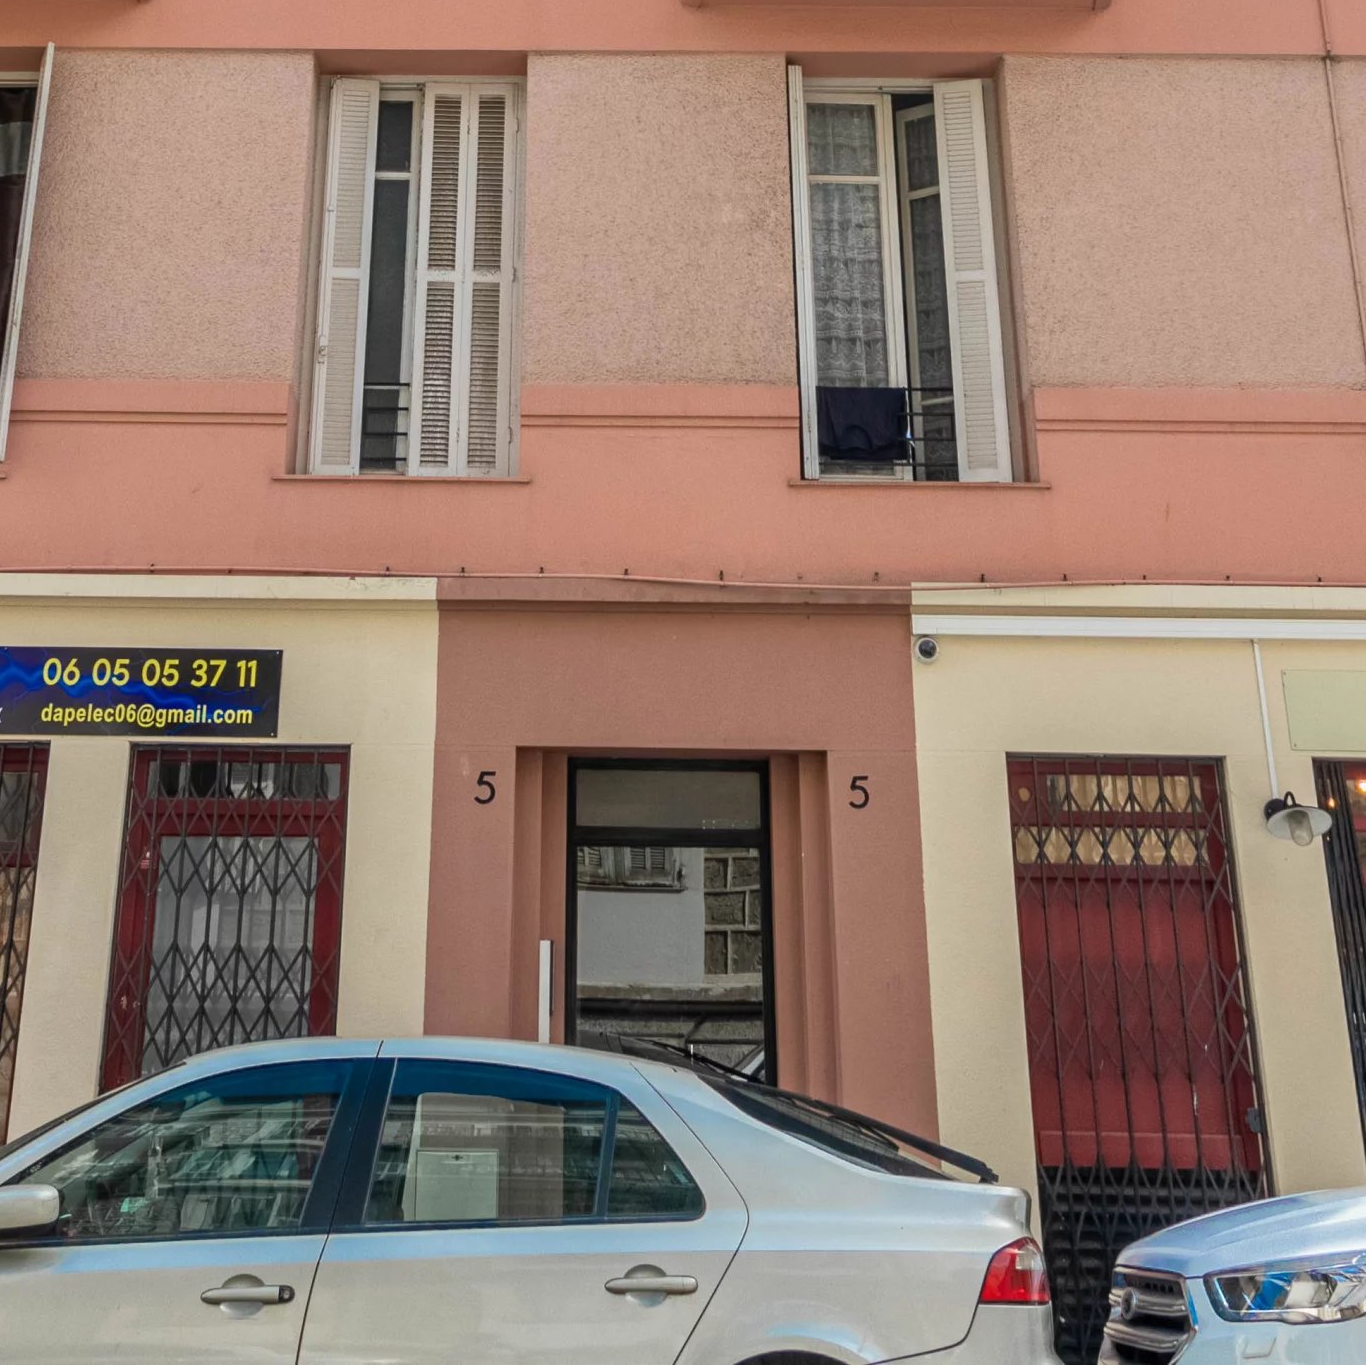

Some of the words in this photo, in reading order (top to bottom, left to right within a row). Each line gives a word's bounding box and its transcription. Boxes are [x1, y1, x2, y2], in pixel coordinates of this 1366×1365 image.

[42, 657, 81, 686] 06
[91, 658, 131, 687] 05
[141, 659, 181, 687] 05
[190, 659, 227, 688] 37
[236, 659, 258, 688] 11
[40, 703, 253, 728] dapelec06@gmail.com
[473, 770, 497, 805] 5
[848, 775, 871, 809] 5
